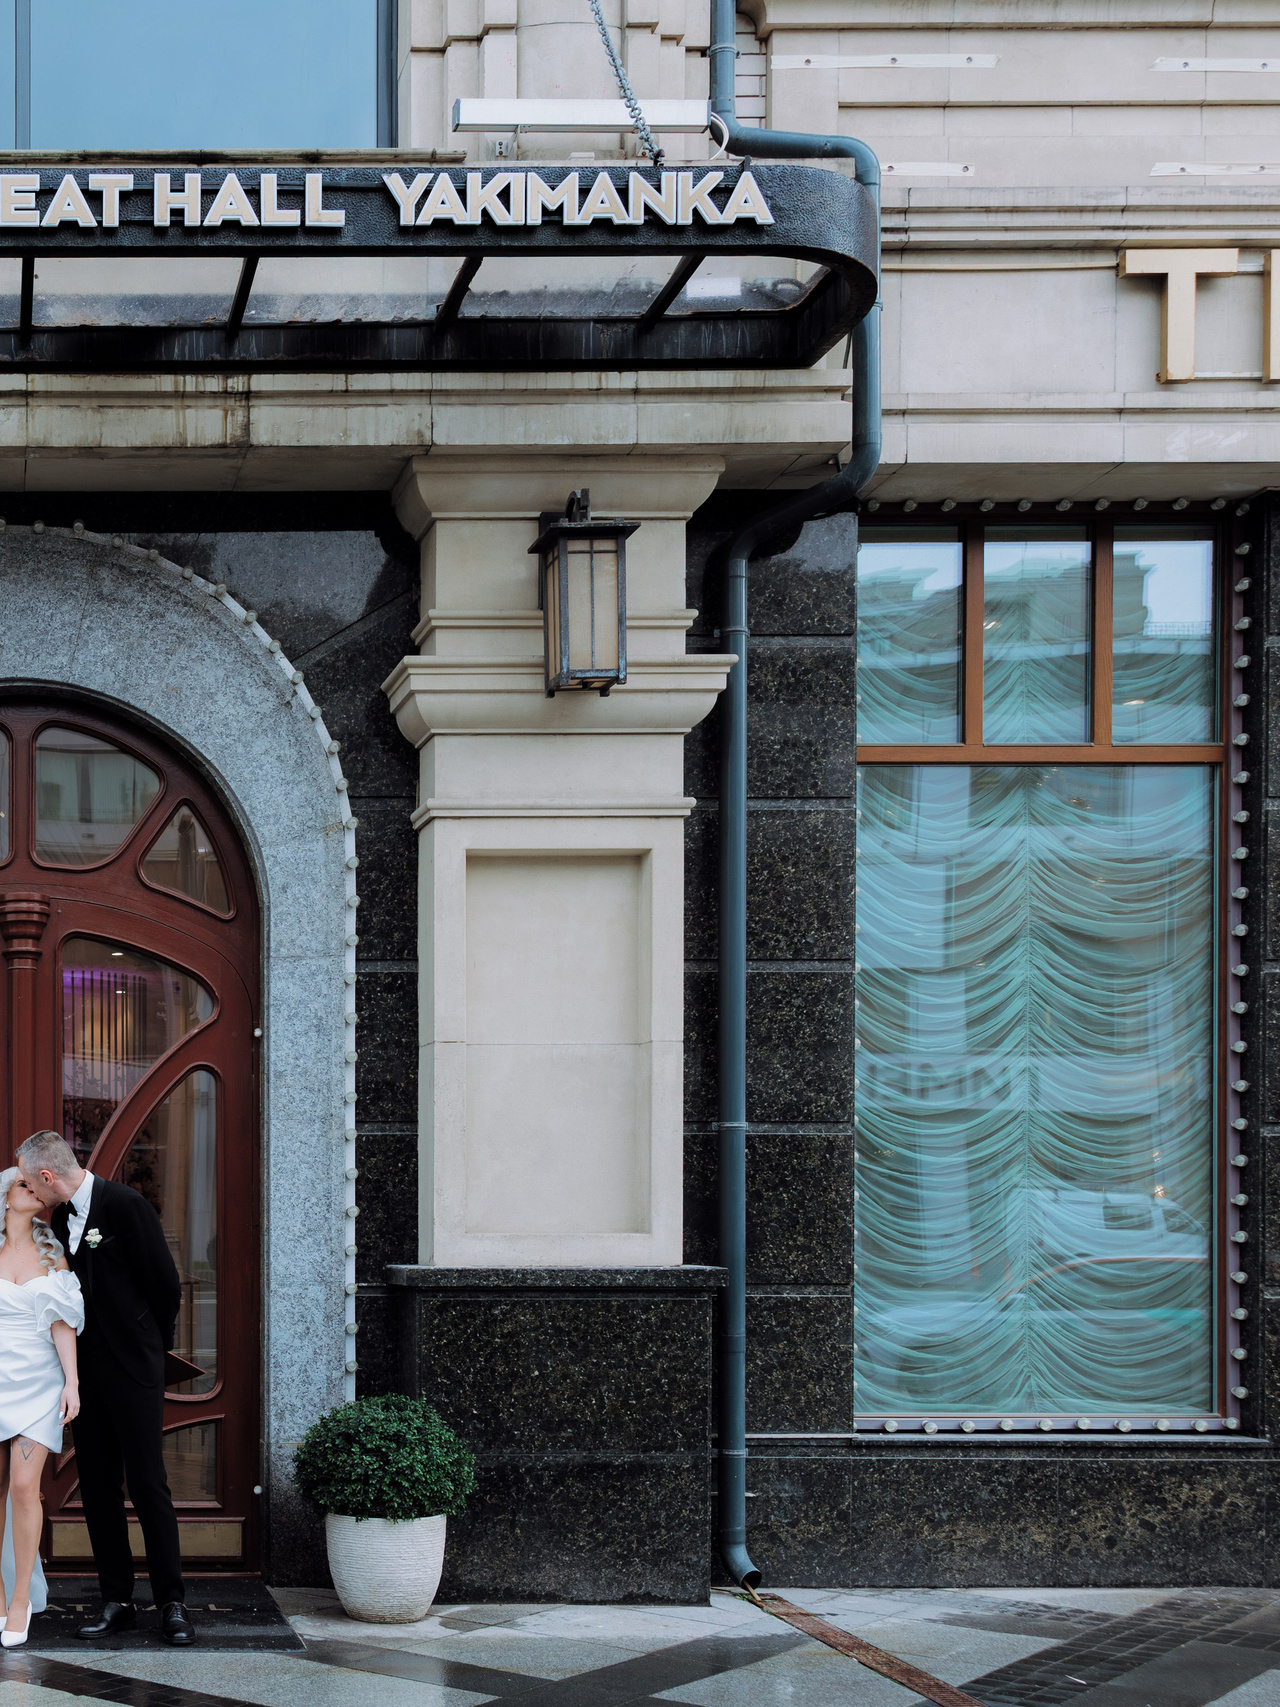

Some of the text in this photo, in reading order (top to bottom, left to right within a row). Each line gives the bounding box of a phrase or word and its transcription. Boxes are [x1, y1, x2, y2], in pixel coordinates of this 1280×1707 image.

[153, 172, 346, 228] HALL
[381, 171, 775, 226] YAKIMANKA
[1119, 248, 1280, 384] T
